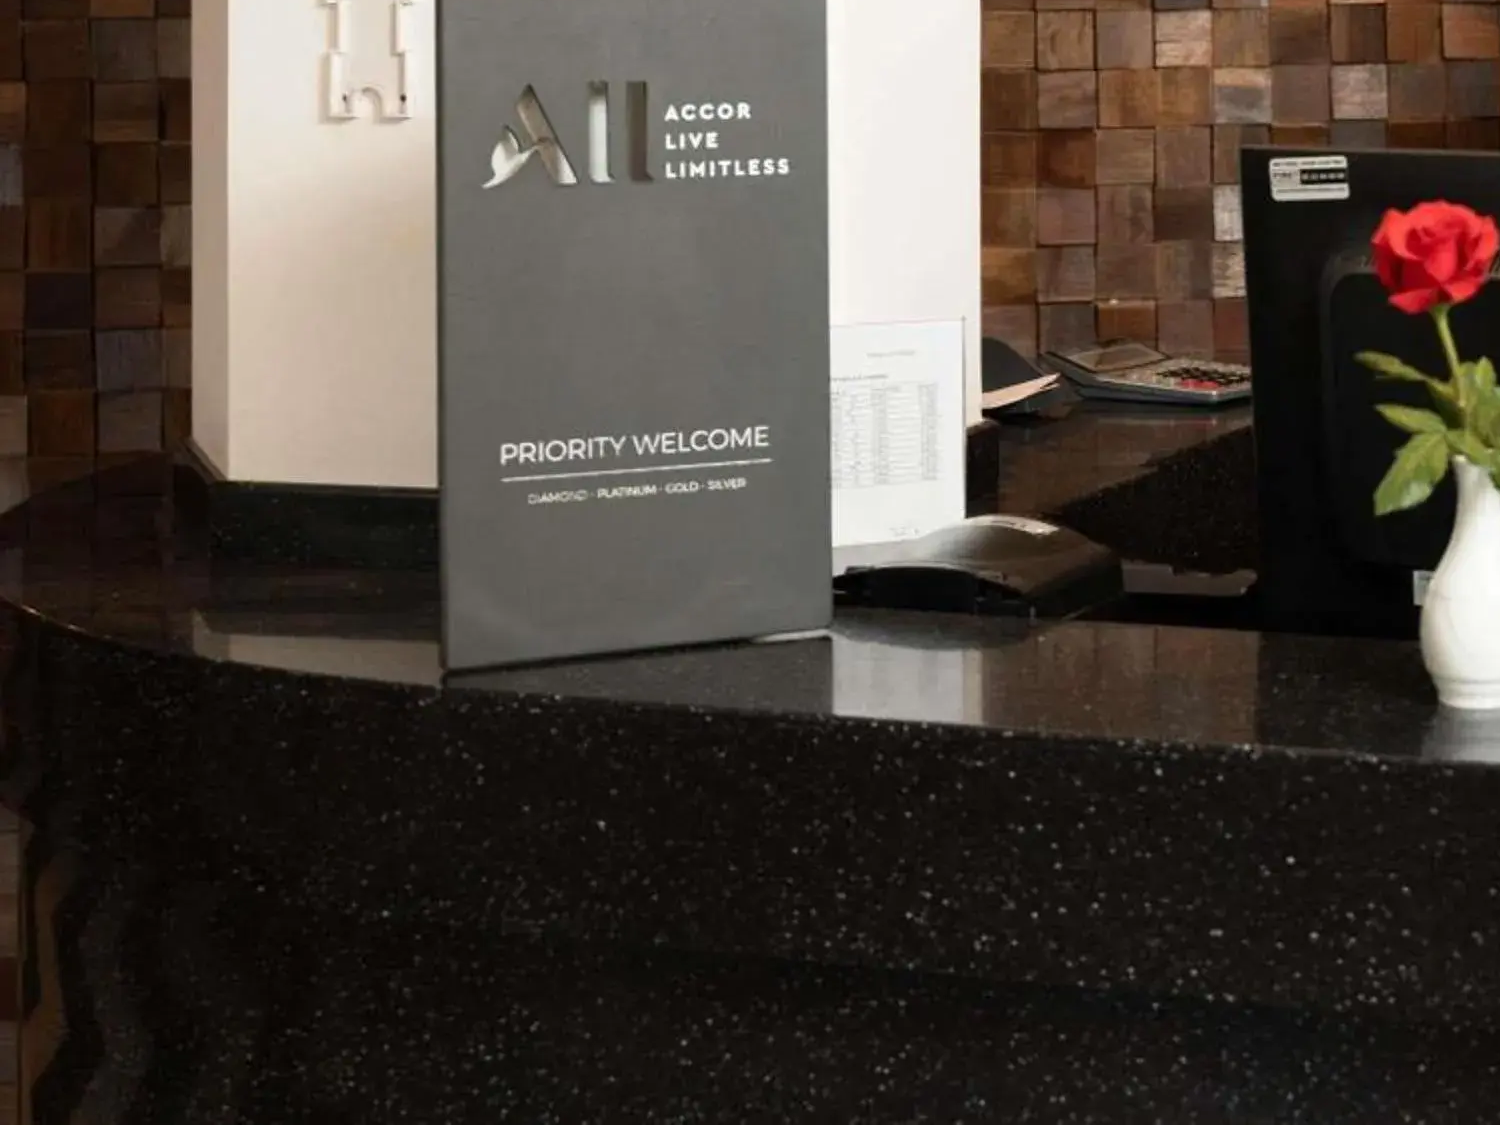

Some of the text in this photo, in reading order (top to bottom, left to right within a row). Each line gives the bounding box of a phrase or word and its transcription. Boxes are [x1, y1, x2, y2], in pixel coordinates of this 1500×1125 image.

[664, 102, 752, 121] ACCOR
[665, 131, 719, 149] LIVE
[665, 158, 791, 179] LIMITLESS
[501, 425, 770, 465] PRIORITY WELCOME
[528, 477, 747, 505] DIAMOND PLATINUM GOLD SILVER
